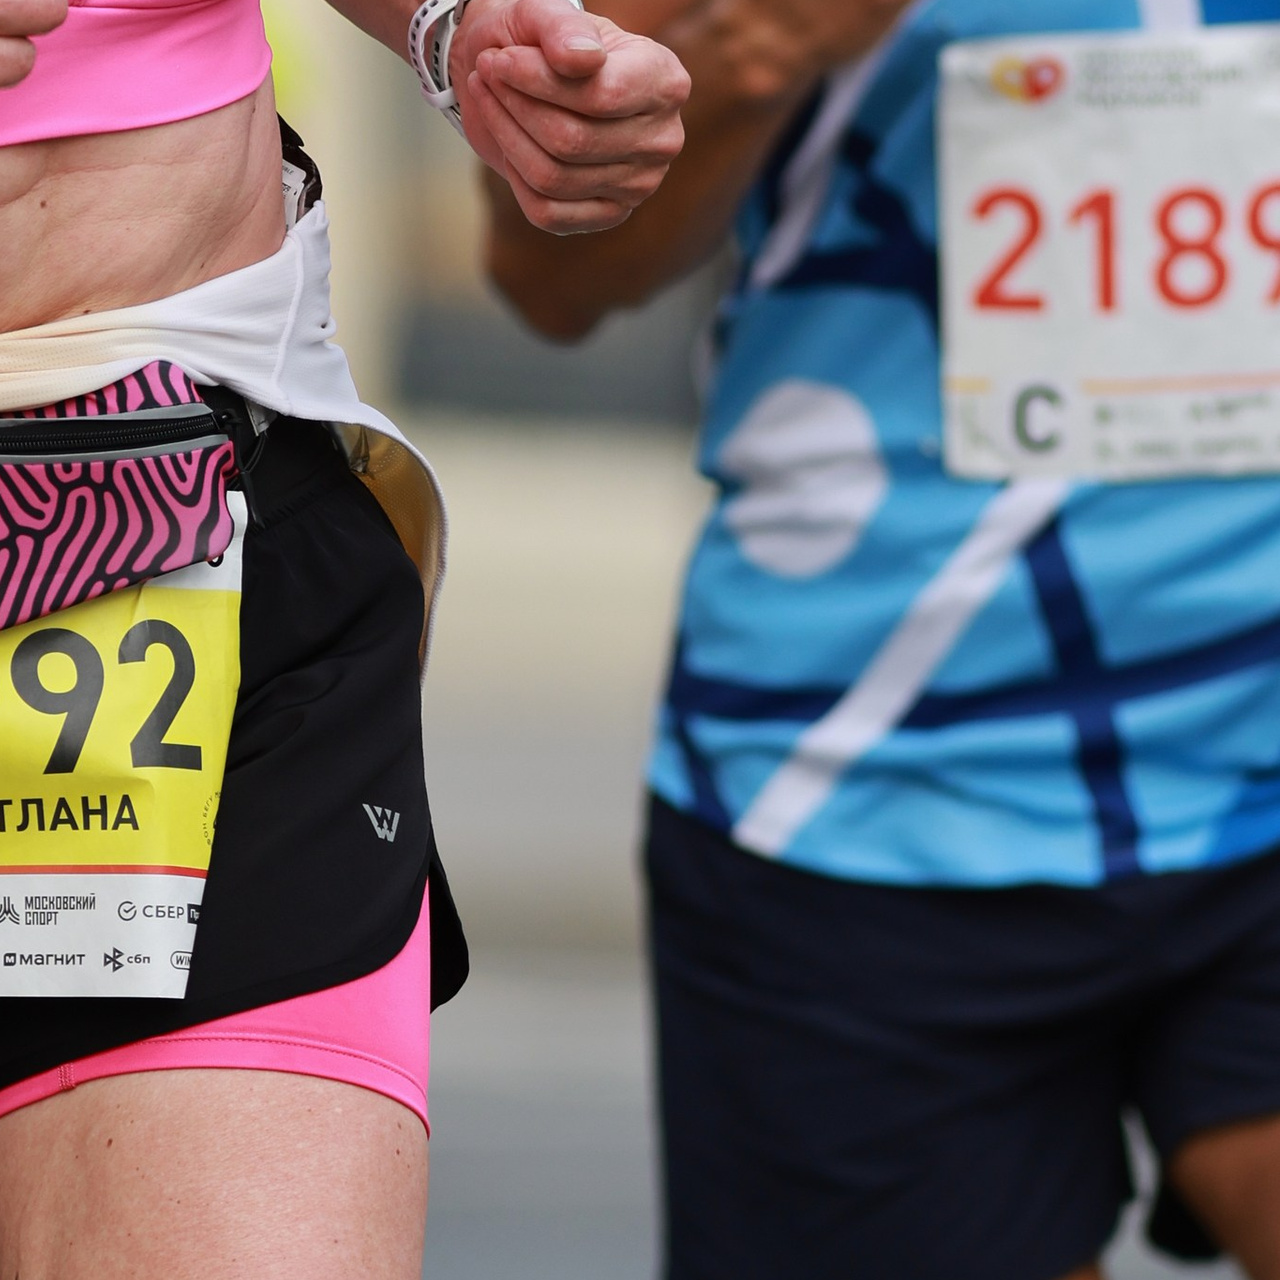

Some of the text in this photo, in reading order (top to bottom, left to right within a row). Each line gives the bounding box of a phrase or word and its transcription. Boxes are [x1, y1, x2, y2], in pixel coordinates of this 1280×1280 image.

[1014, 383, 1064, 453] C
[24, 893, 96, 911] МОСКОВСКИЙ
[24, 911, 59, 926] СПОРТ
[142, 905, 185, 919] СБЕР
[19, 953, 86, 966] магнит
[127, 954, 151, 964] сбп
